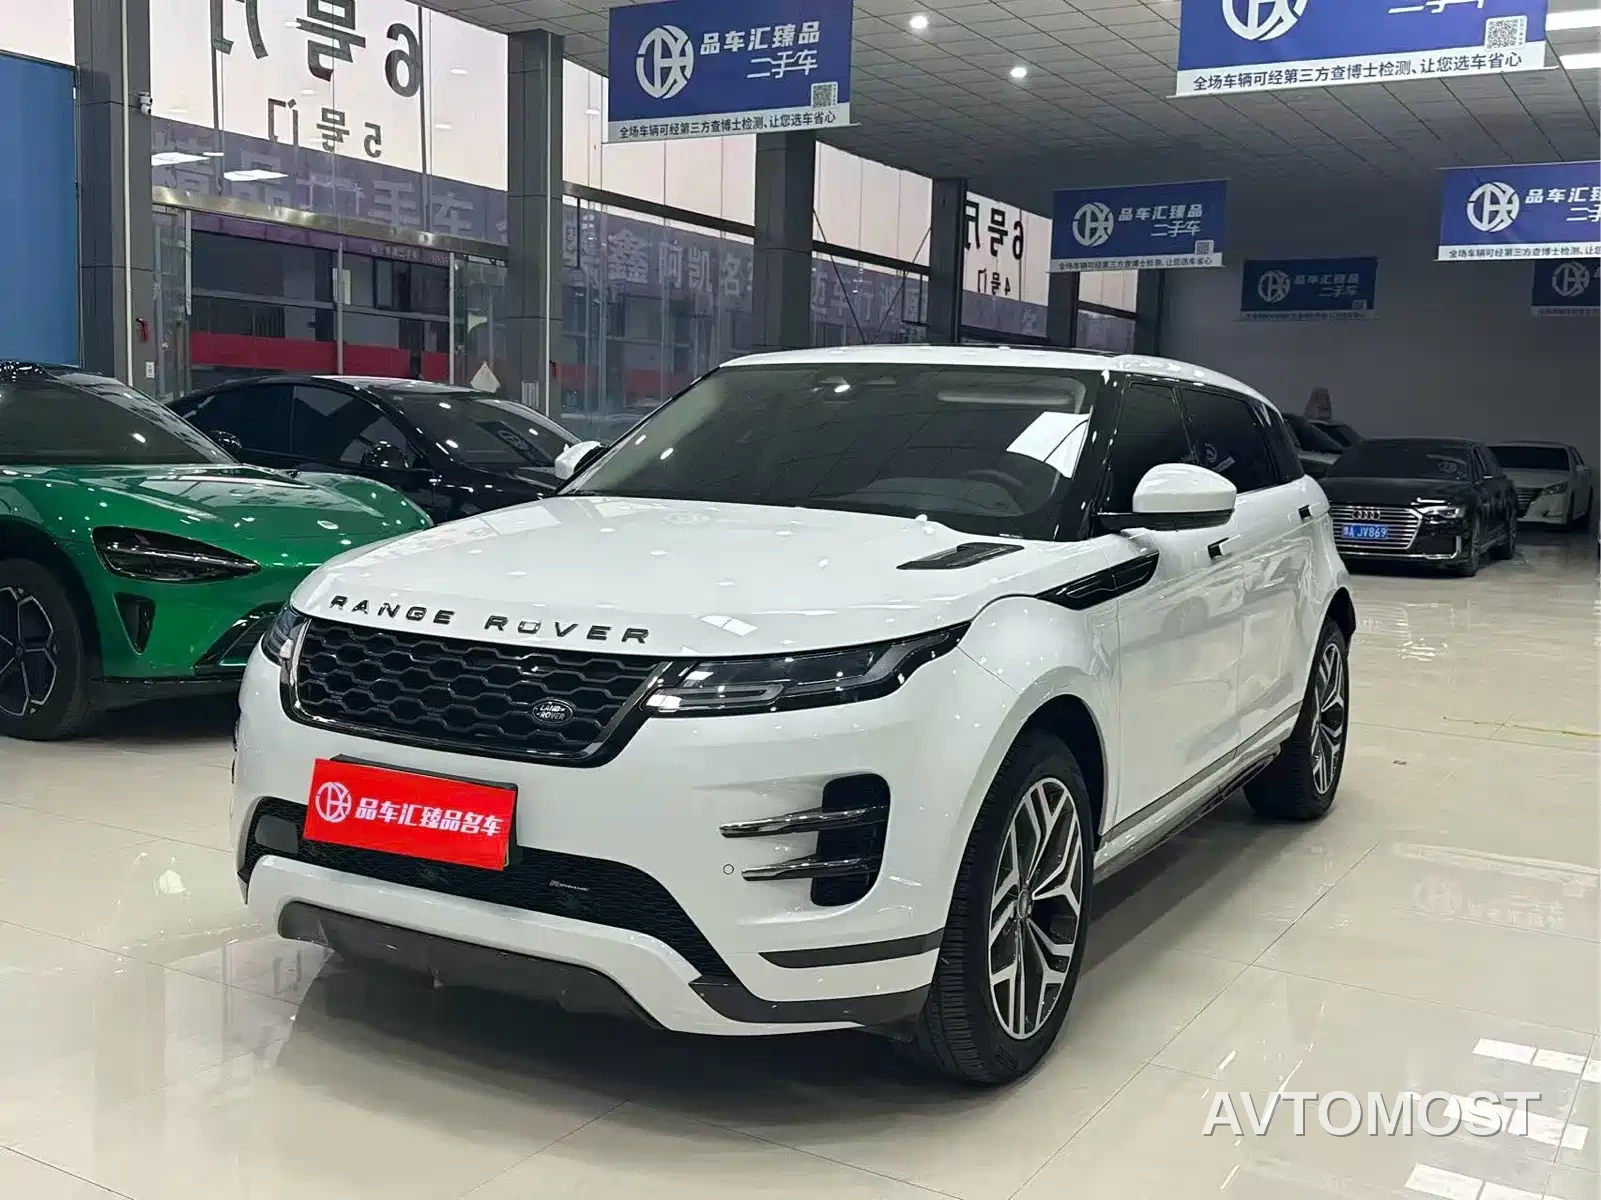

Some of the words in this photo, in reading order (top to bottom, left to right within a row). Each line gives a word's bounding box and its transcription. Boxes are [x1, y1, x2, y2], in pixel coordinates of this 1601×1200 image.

[700, 20, 821, 55] 品车汇臻品
[747, 49, 818, 79] 二手车
[1193, 51, 1522, 92] 全场车辆可经第三方查博士检测、让您选车省心
[619, 111, 836, 140] 全场车辆可经第三方查博士检测、让您选车省心
[1118, 203, 1203, 222] 品车汇臻品
[1151, 220, 1201, 238] 二手车
[1357, 527, 1387, 539] JV869
[329, 595, 455, 624] RANGE
[484, 615, 649, 644] ROVER
[540, 711, 566, 720] ROVER
[355, 797, 503, 837] 品车汇臻品名车
